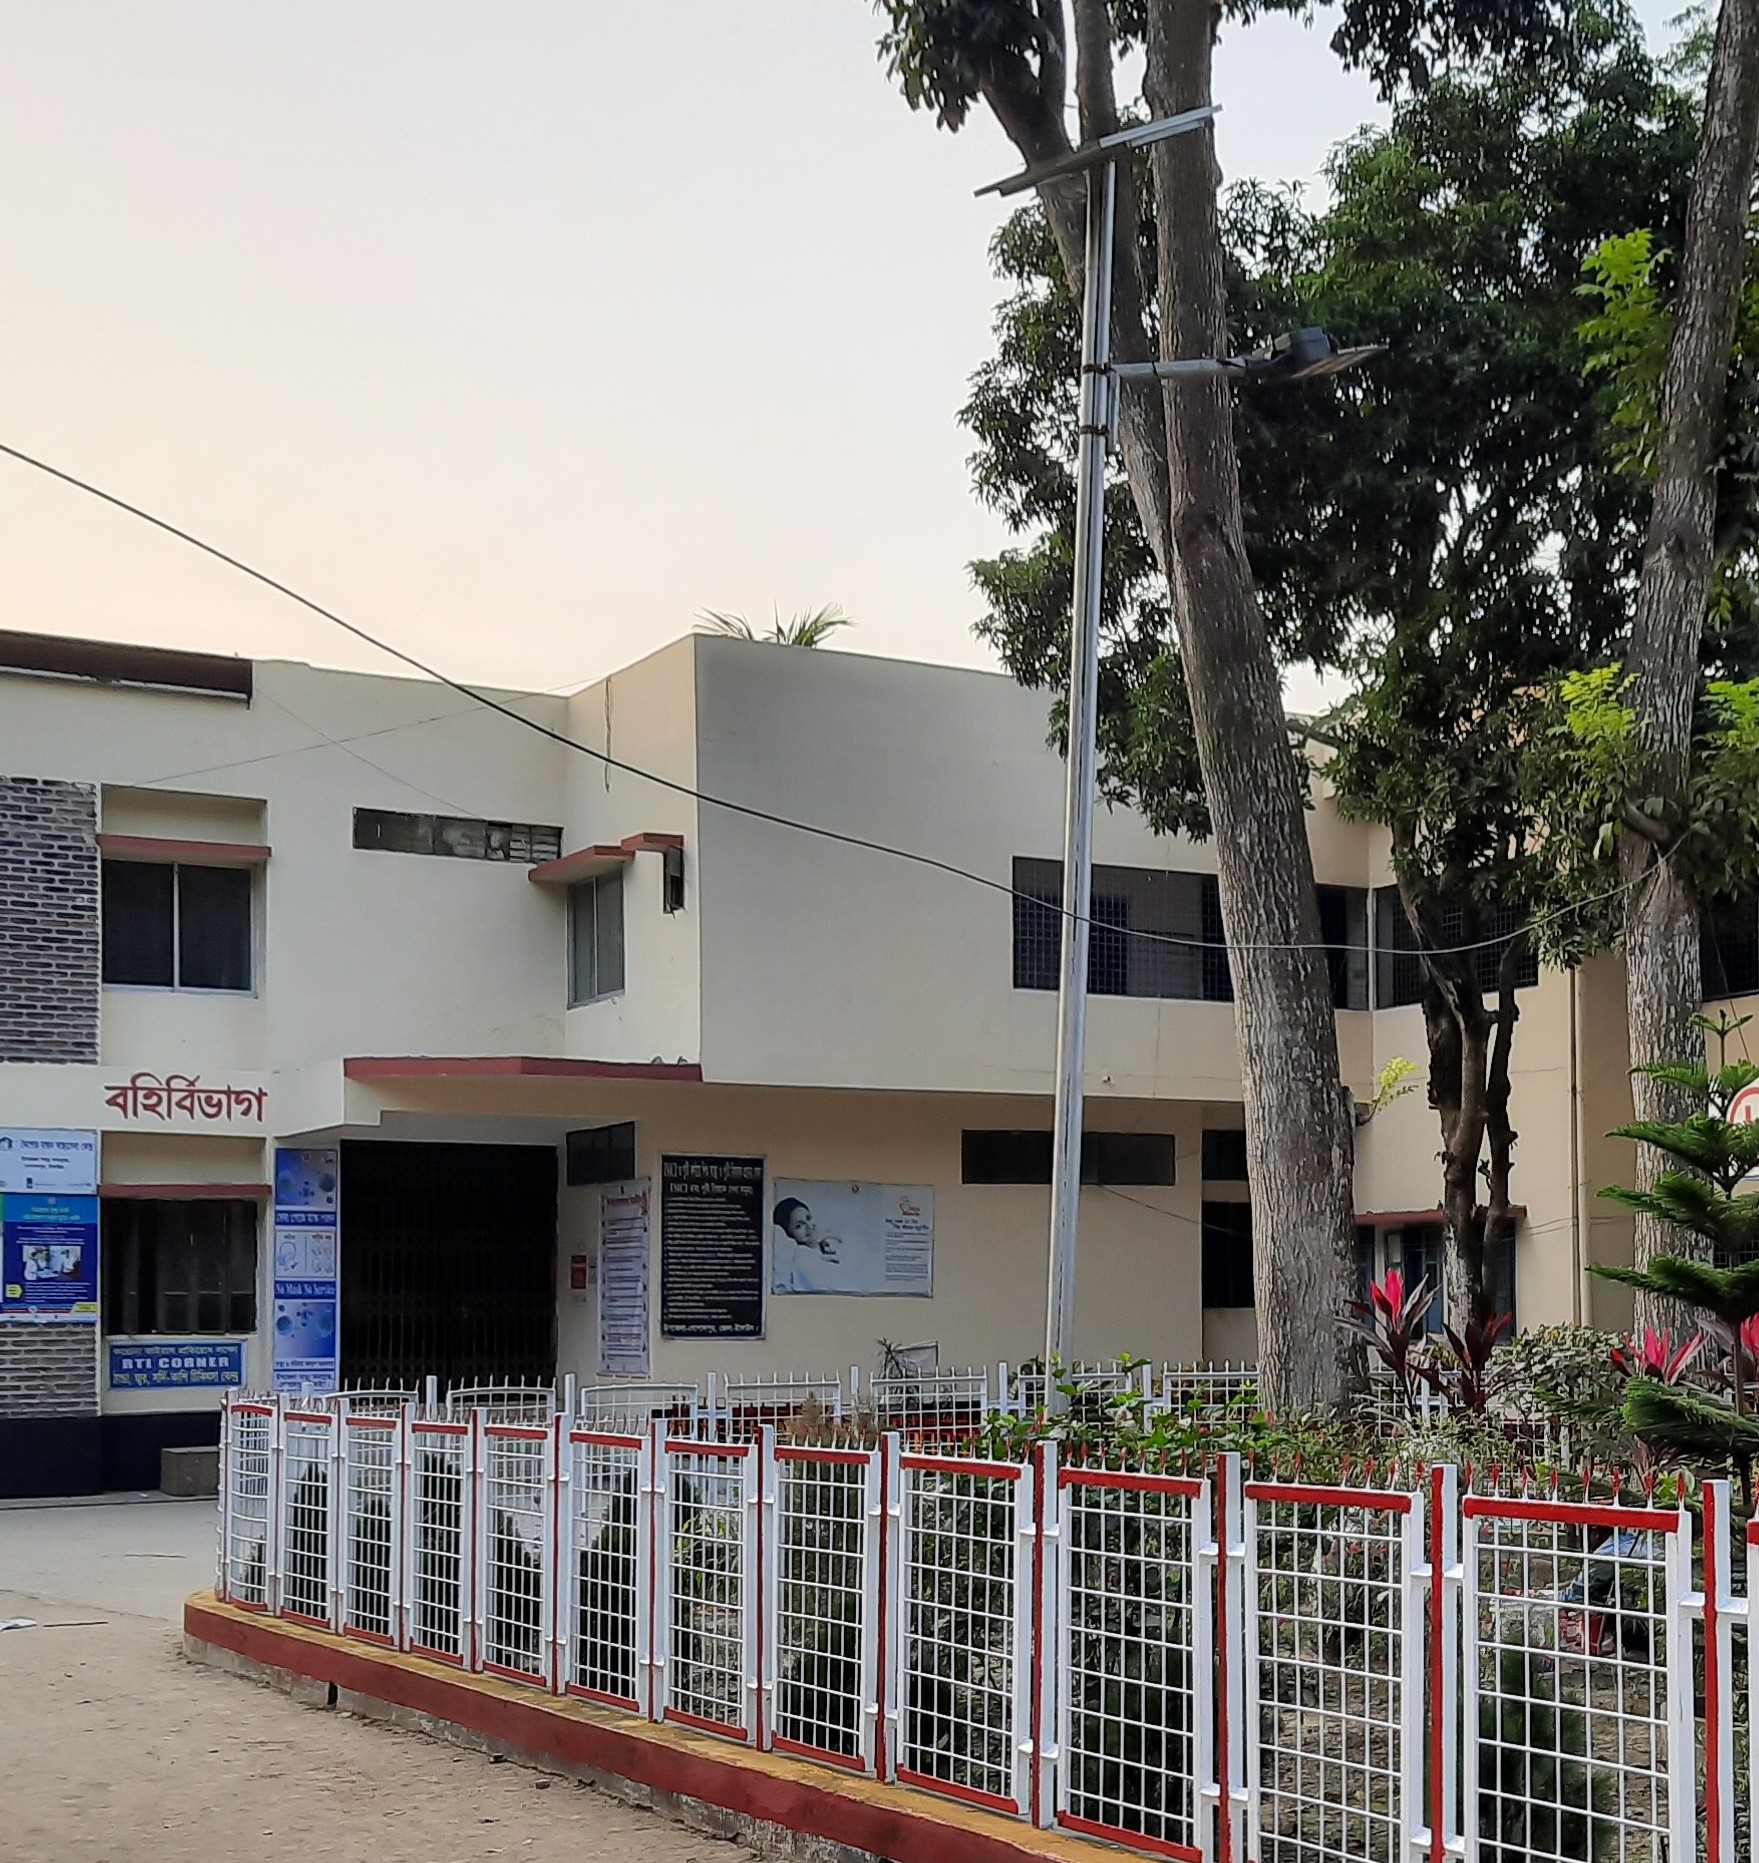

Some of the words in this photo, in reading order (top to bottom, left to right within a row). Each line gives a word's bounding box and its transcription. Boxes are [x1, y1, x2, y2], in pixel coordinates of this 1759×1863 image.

[104, 1072, 268, 1122] বহির্বিভাগ
[122, 1357, 152, 1369] RTI
[158, 1356, 229, 1369] CORNER
